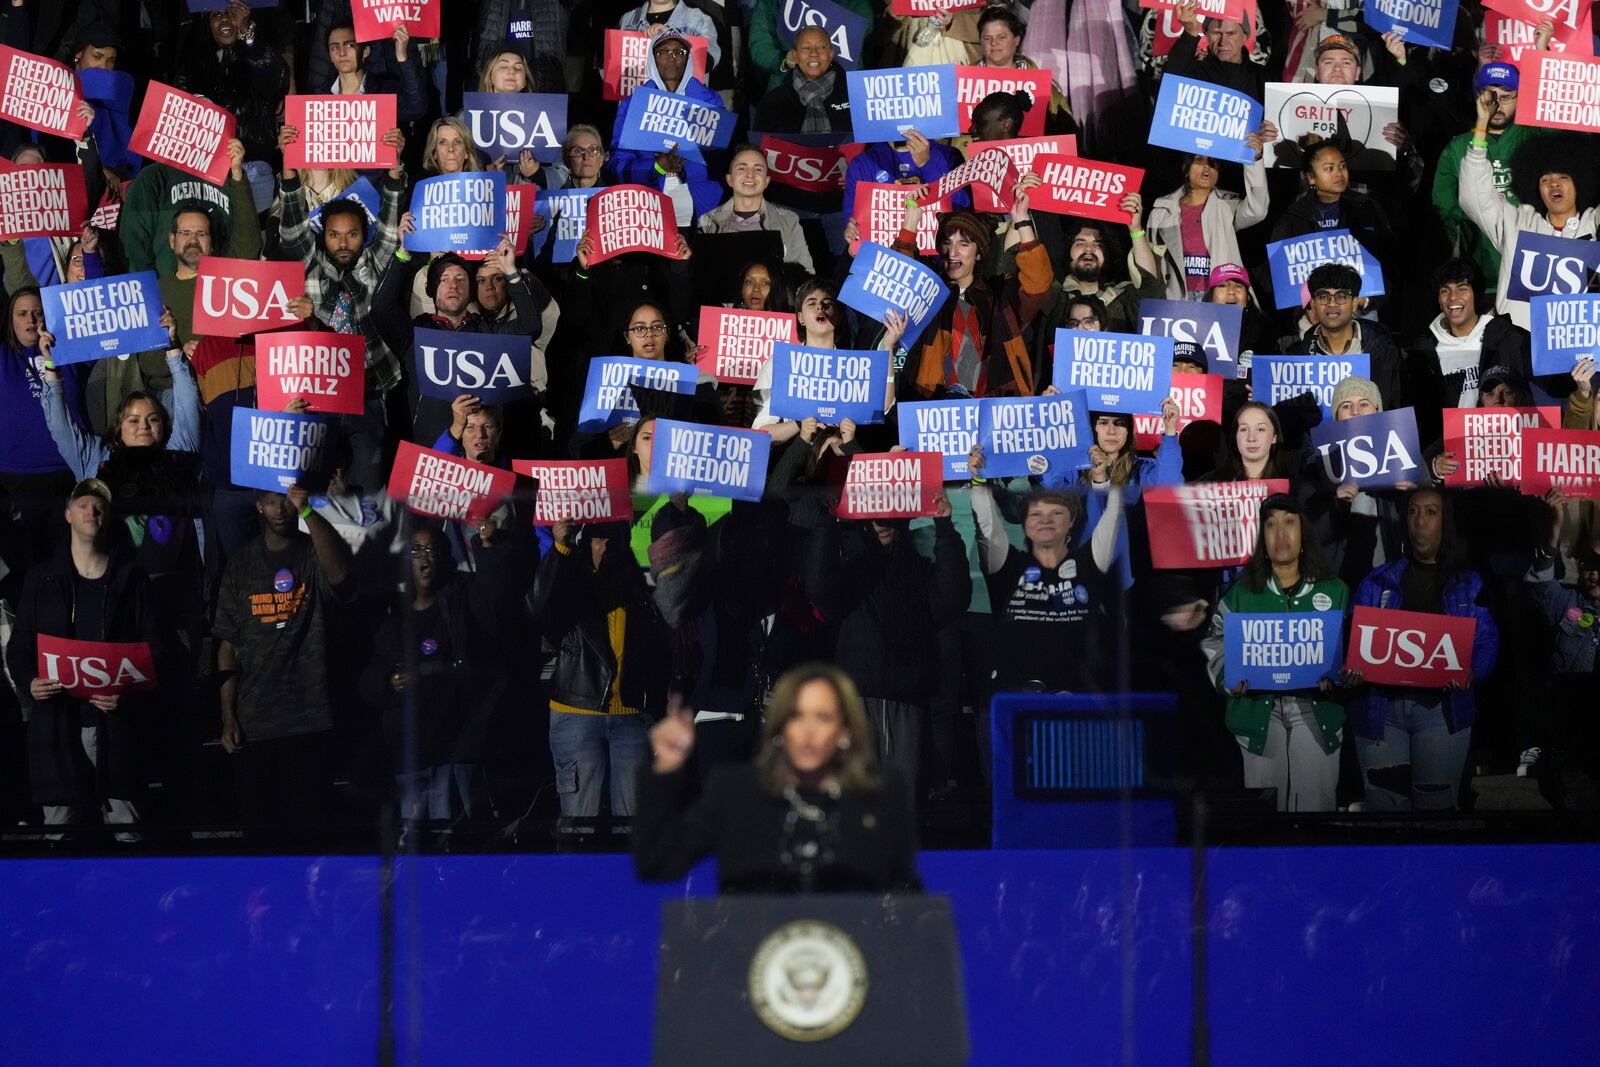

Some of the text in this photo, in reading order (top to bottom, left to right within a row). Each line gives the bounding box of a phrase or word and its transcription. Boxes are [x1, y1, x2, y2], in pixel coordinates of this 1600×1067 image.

[374, 6, 420, 23] WALZ
[10, 54, 74, 90] FREEDOM
[1540, 58, 1600, 83] FREEDO
[4, 75, 74, 111] FREEDOM
[864, 72, 940, 98] VOTE FOR
[1538, 80, 1600, 105] FREEDO
[0, 94, 70, 131] FREEDOM
[161, 92, 226, 134] FREEDOM
[305, 100, 376, 121] FREEDOM
[646, 94, 720, 128] VOTE FOR
[866, 92, 942, 120] FREEDOM
[1177, 82, 1252, 120] VOTE FOR
[1296, 106, 1352, 122] GRITTY
[154, 112, 222, 154] FREEDOM
[305, 122, 376, 142] FREEDOM
[468, 110, 562, 148] USA
[640, 112, 715, 147] FREEDOM
[1170, 104, 1248, 140] FREEDOM
[1313, 122, 1337, 134] FOR
[146, 133, 214, 173] FREEDOM
[305, 142, 376, 163] FREEDOM
[764, 148, 848, 182] USA
[1000, 142, 1058, 165] EEDOM
[0, 168, 65, 193] REEDOM
[1043, 162, 1126, 194] HARRIS
[0, 190, 68, 214] REEDOM
[171, 182, 202, 204] OCEAN
[424, 178, 494, 206] VOTE FOR
[598, 190, 662, 214] FREEDOM
[1052, 187, 1107, 207] WALZ
[422, 203, 494, 230] FREEDOM
[548, 194, 588, 218] VOTE
[598, 207, 664, 232] FREEDOM
[871, 210, 938, 231] FREEOM
[600, 227, 664, 254] FREEDOM
[870, 231, 936, 250] FREOM
[1284, 234, 1361, 264] VOTE FOR
[1184, 256, 1210, 268] HARRI
[1520, 249, 1588, 294] US
[873, 250, 940, 307] VOTE FOR
[60, 280, 144, 315] VOTE FOR
[200, 275, 298, 321] USA
[862, 270, 930, 326] FREEDOM
[64, 303, 148, 340] FREEDOM
[1546, 300, 1588, 325] VOTE
[720, 314, 792, 340] FREEDOM
[1141, 317, 1232, 362] USA
[718, 334, 775, 360] FREEDO
[1073, 337, 1155, 367] VOTE FOR
[269, 345, 350, 378] HARRIS
[420, 345, 525, 389] USA
[716, 356, 762, 379] FREED
[790, 351, 834, 374] VOTE
[838, 354, 872, 380] FOR
[1270, 362, 1352, 386] VOTE FOR
[280, 376, 338, 396] WALZ
[602, 364, 680, 392] VOTE FOR
[788, 374, 870, 403] FREEDOM
[1070, 362, 1154, 391] FREEDOM
[597, 386, 640, 412] FREE
[1100, 394, 1120, 402] HARRIS
[1170, 386, 1206, 418] RIS
[1272, 384, 1334, 407] FREDO
[817, 406, 836, 414] HARRIS
[916, 406, 962, 432] VOTE
[992, 403, 1035, 430] VOTE
[1040, 400, 1074, 424] FOR
[251, 416, 327, 448] VOTE FOR
[992, 423, 1077, 454] FREEDOM
[1464, 414, 1540, 436] FREEDOM
[671, 427, 752, 462] VOTE FOR
[918, 430, 978, 456] FREED
[1465, 436, 1522, 458] FREEDO
[666, 453, 750, 488] FREEDOM
[847, 458, 921, 482] FREEDOM
[1318, 430, 1418, 484] USA
[1466, 458, 1522, 481] FREEDO
[1537, 442, 1600, 474] HARR
[414, 452, 494, 496] FREEDOM
[532, 466, 606, 490] FREEDOM
[535, 498, 612, 522] FREEDOM
[1195, 521, 1260, 560] FREEDO
[1242, 619, 1324, 643] VOTE FOR
[1242, 642, 1324, 667] FREEDOM
[1358, 624, 1463, 671] USA
[42, 652, 150, 689] USA
